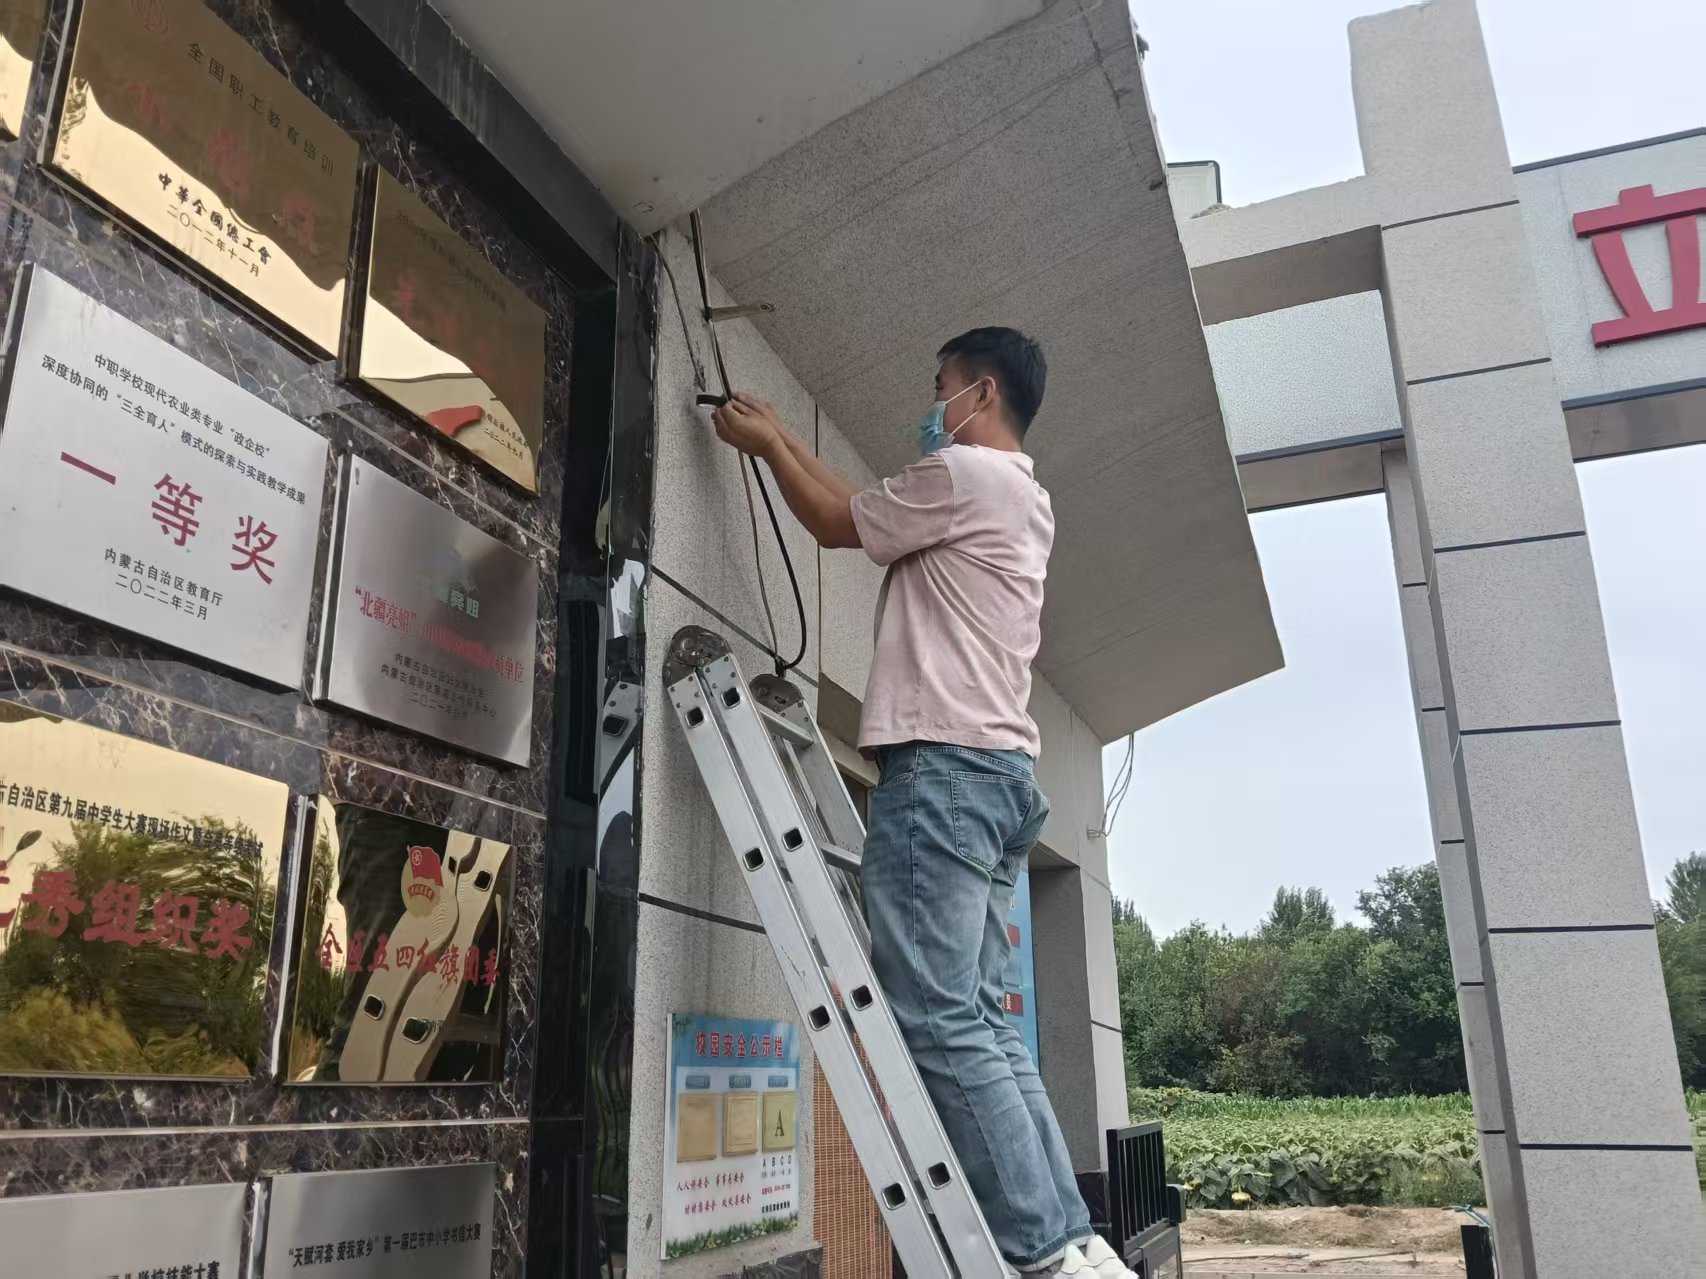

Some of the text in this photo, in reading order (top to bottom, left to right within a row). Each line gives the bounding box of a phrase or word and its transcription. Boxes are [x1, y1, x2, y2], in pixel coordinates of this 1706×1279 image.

[188, 43, 334, 177] 全国职工教育培训
[1573, 184, 1706, 347] 立
[60, 451, 278, 585] 一等奖
[105, 548, 223, 606] 内蒙古自治区教育厅
[0, 858, 252, 961] 秀组织奖
[696, 1031, 784, 1059] 校园安全公示栏
[774, 1108, 785, 1136] A
